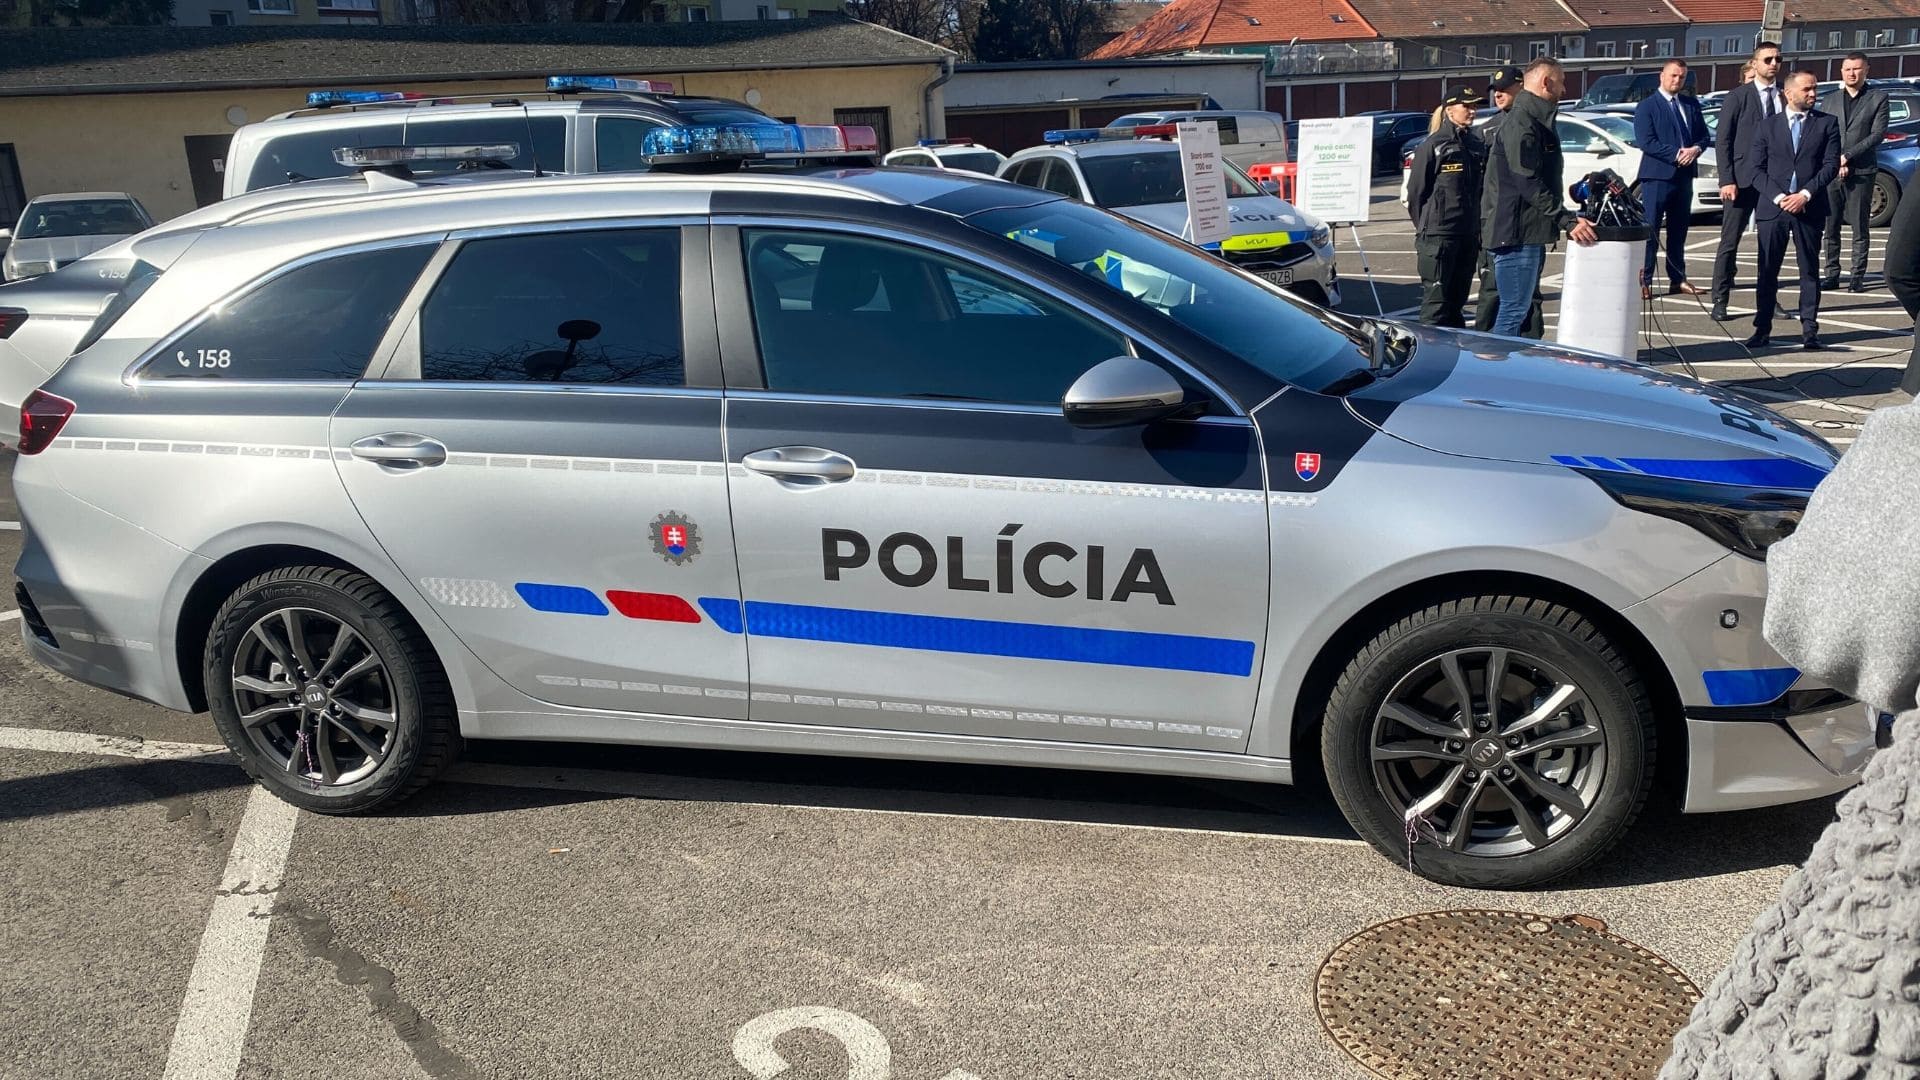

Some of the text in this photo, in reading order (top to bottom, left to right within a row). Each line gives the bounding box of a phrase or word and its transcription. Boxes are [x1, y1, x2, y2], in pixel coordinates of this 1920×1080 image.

[1260, 270, 1291, 284] 79ZB
[198, 349, 231, 368] 158
[822, 523, 1176, 606] POLÍCIA
[306, 692, 325, 703] KIA
[1475, 742, 1499, 762] KIA
